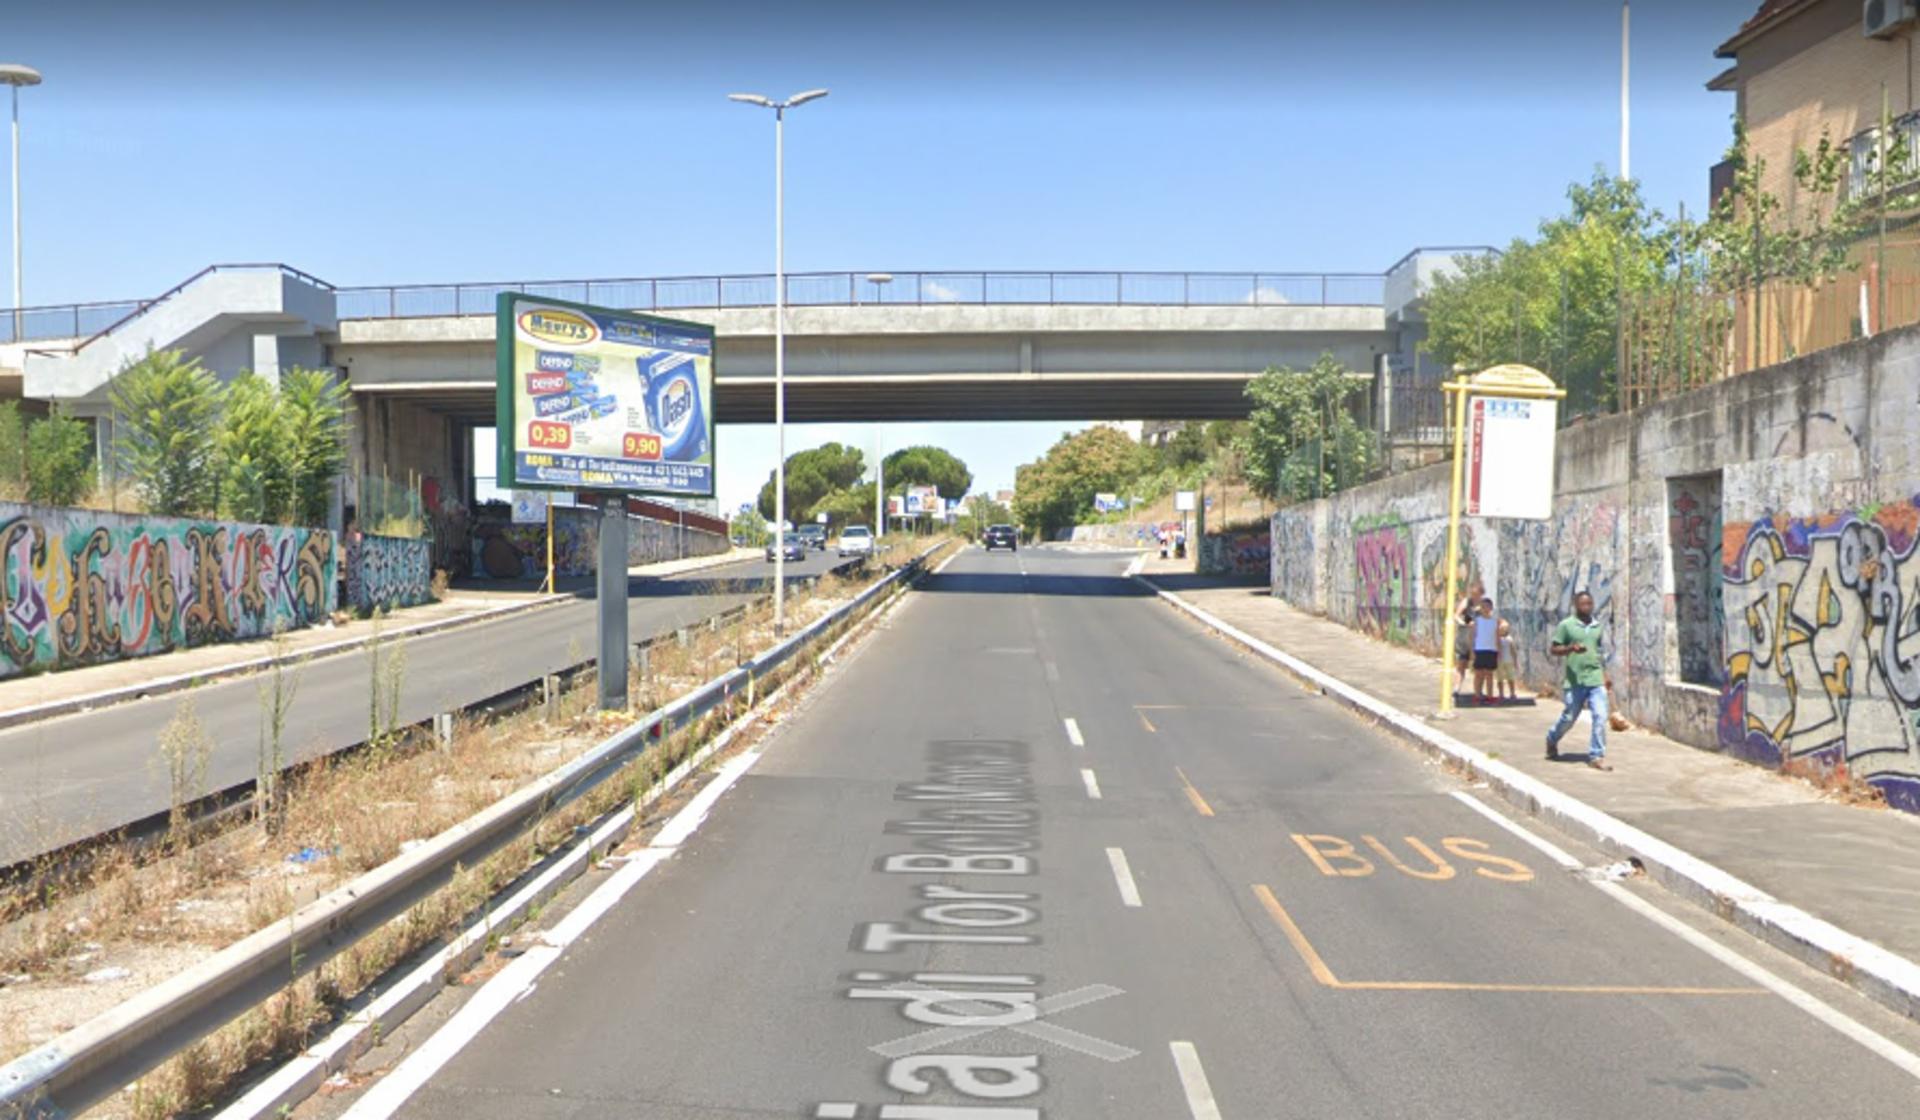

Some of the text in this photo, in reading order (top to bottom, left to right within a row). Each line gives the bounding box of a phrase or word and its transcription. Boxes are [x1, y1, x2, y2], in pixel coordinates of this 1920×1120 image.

[531, 426, 567, 445] 0,39
[625, 436, 658, 455] 9,90
[1289, 833, 1535, 882] BUS
